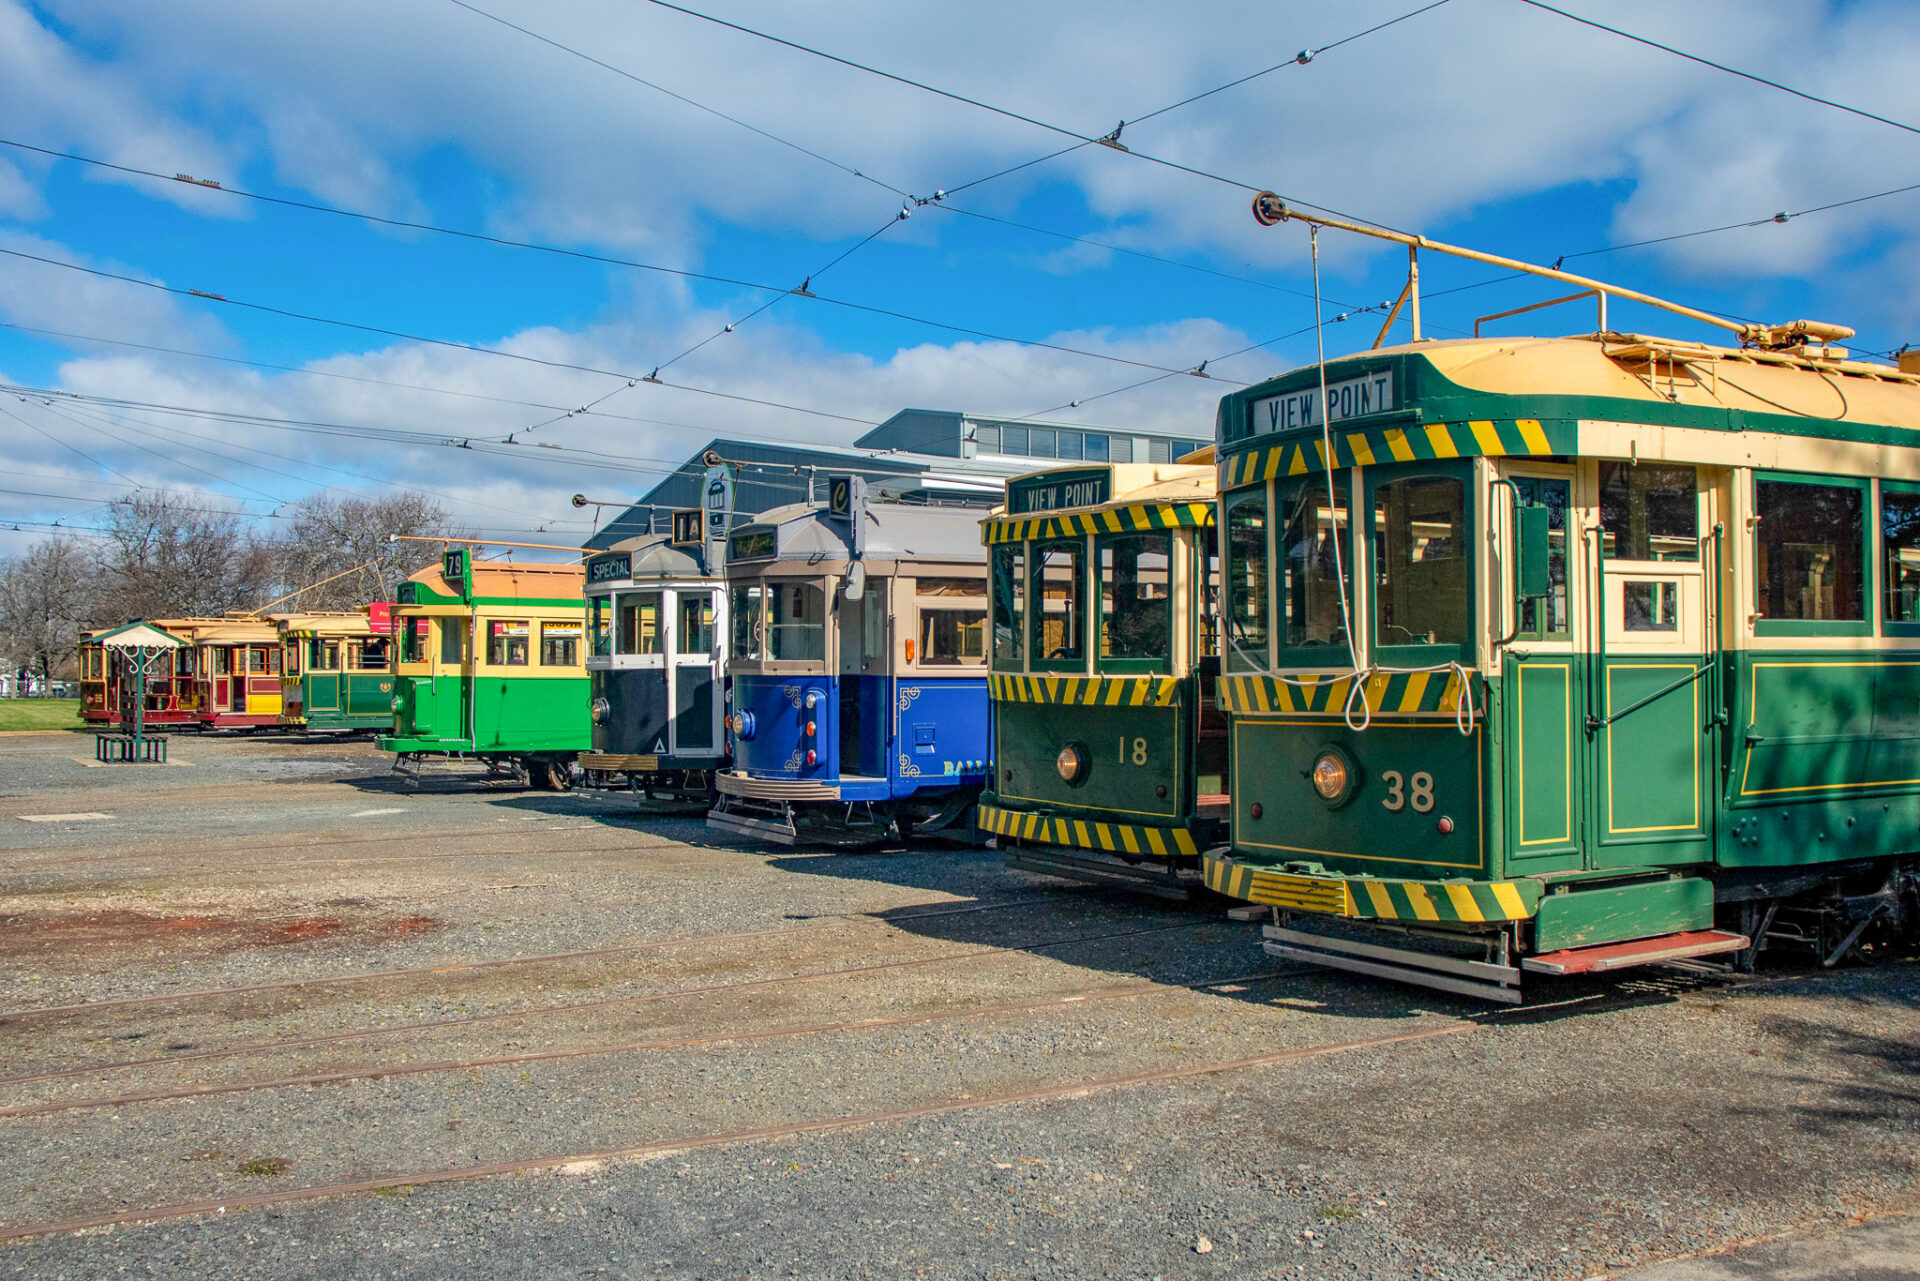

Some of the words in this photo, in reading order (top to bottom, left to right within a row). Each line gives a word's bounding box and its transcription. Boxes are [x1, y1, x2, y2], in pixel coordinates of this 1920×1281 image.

[1269, 394, 1313, 432] VIEW
[1328, 378, 1387, 421] POINT
[1028, 487, 1056, 512] VIEW
[1064, 480, 1102, 508] POINT
[448, 555, 462, 575] 79
[593, 560, 630, 579] SPECIAL
[1119, 736, 1148, 766] 18
[1382, 769, 1435, 813] 38
